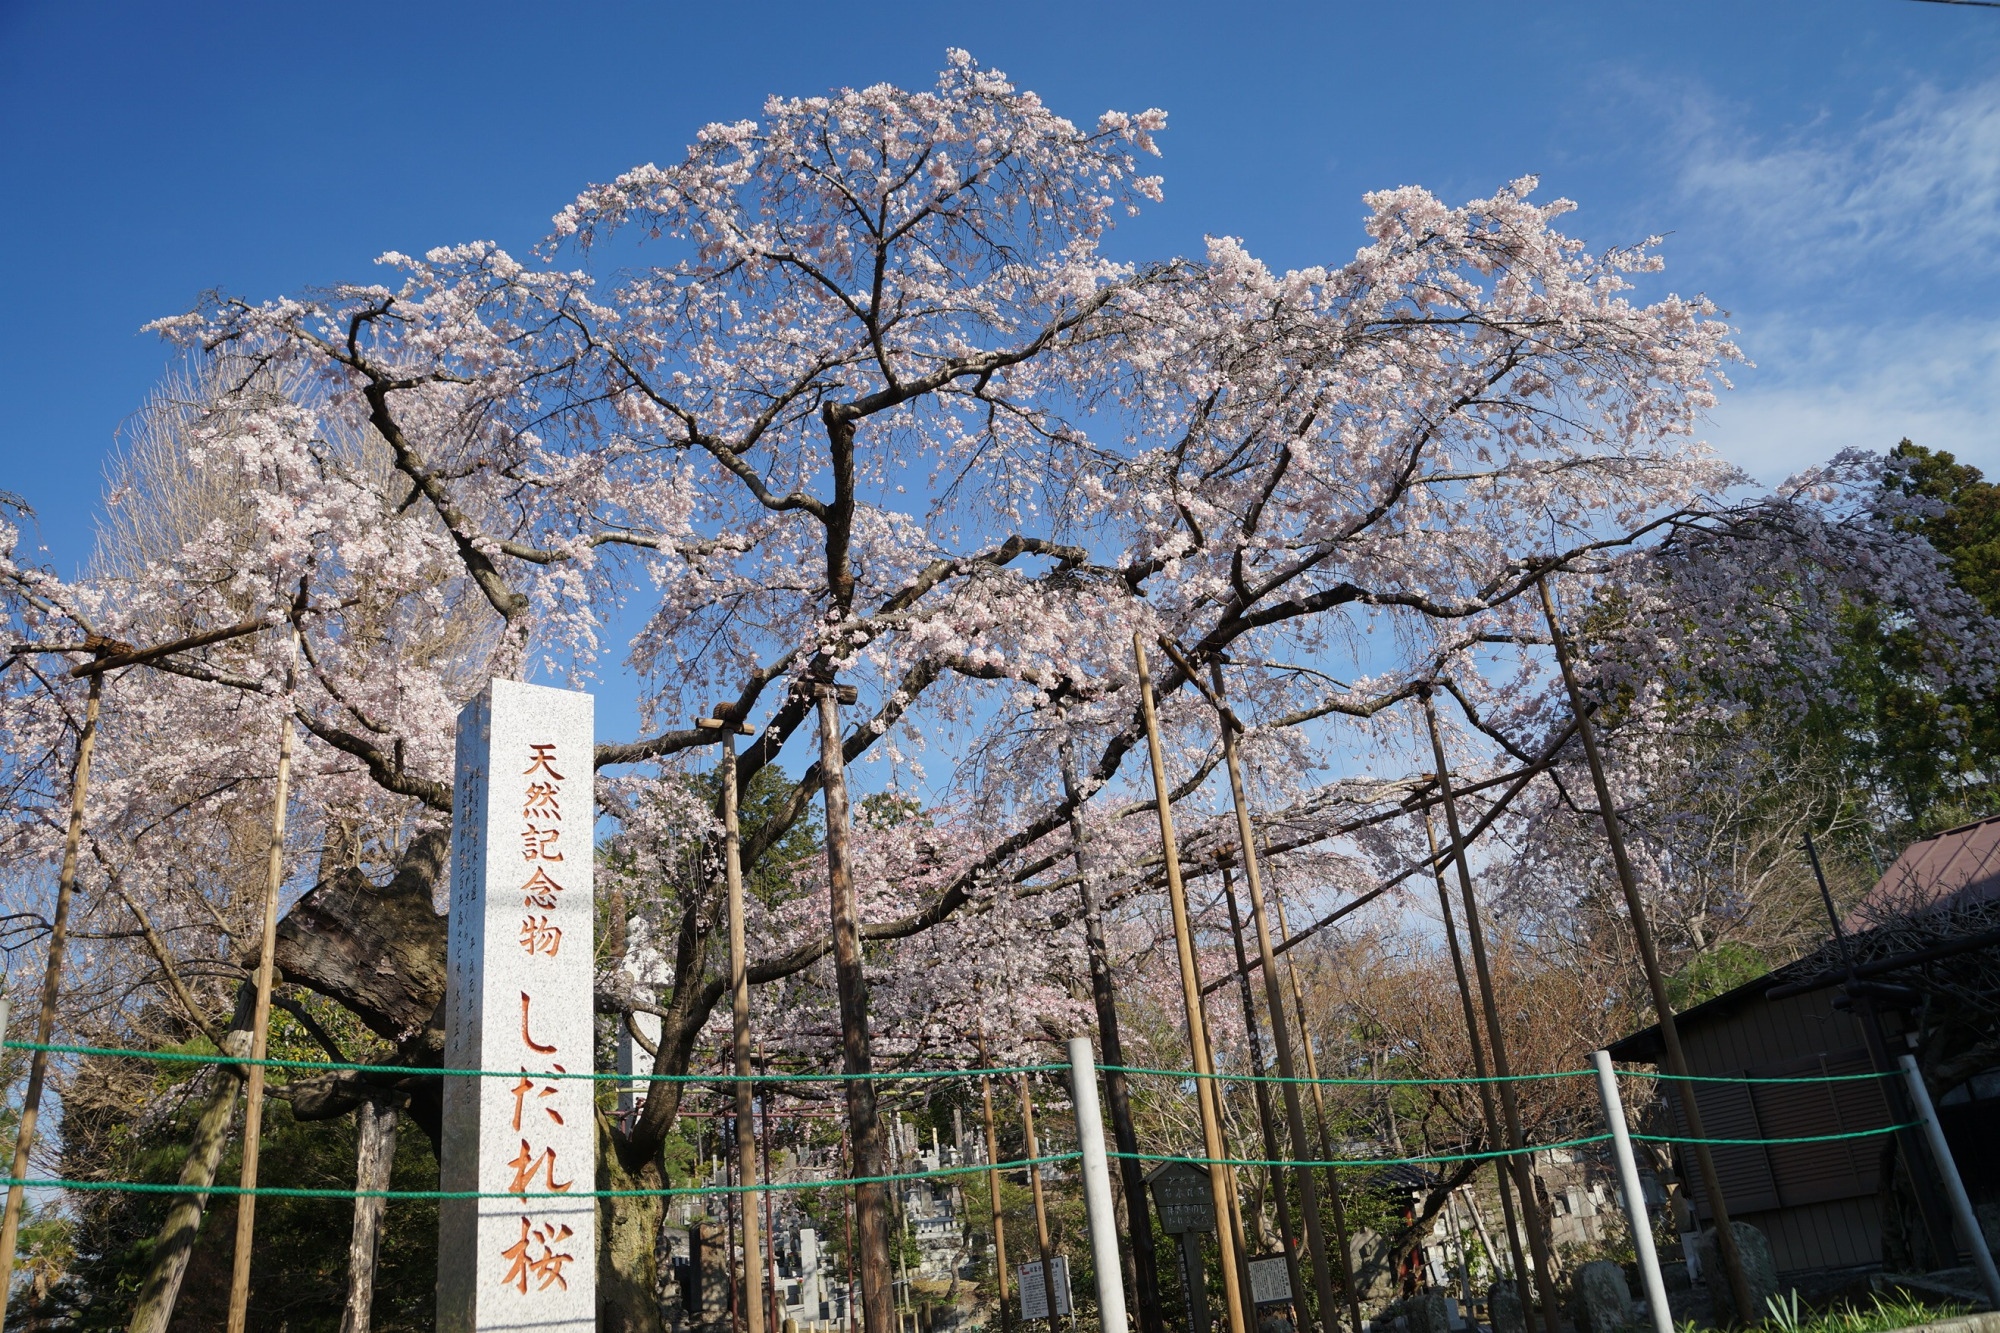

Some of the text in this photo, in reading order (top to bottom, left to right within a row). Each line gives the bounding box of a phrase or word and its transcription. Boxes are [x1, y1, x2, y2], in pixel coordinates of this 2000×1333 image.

[501, 743, 574, 1296] 天然記念物 しだれ桜
